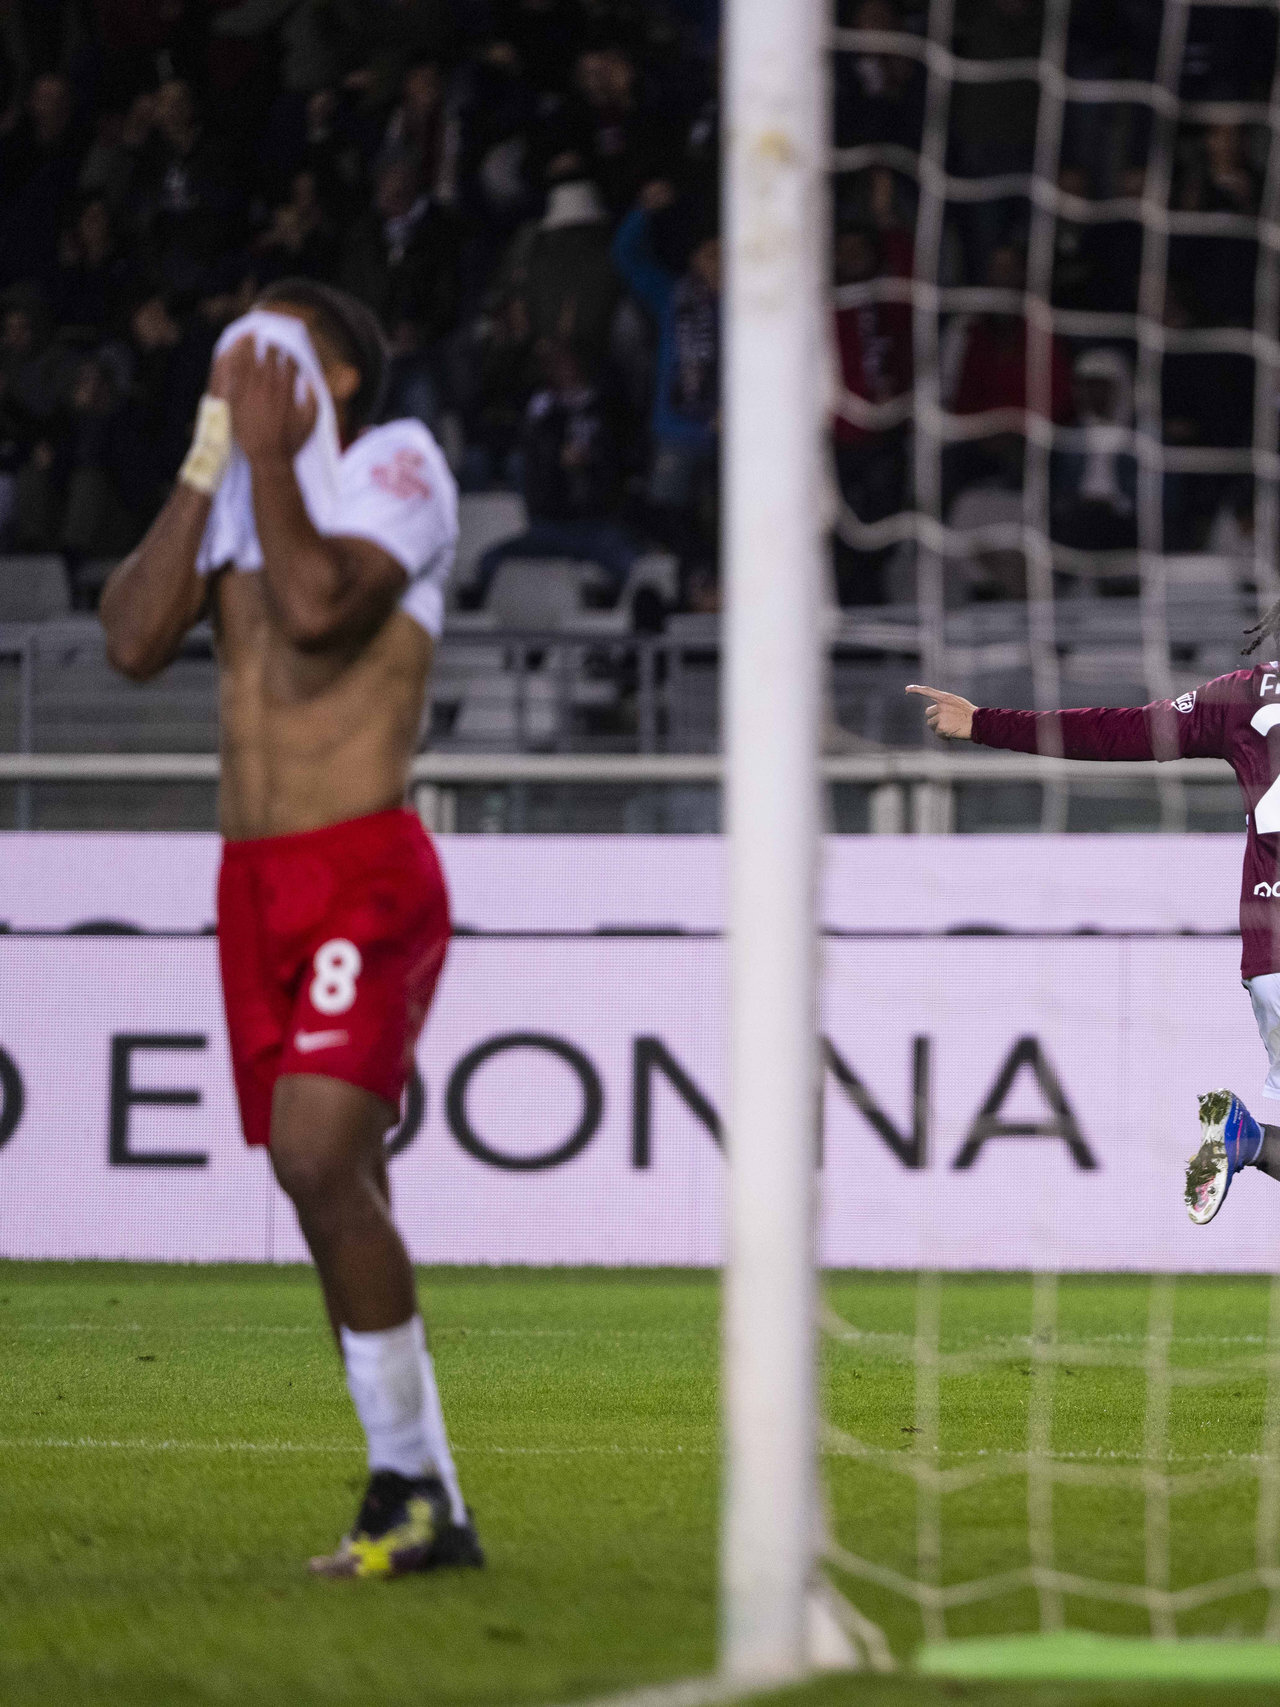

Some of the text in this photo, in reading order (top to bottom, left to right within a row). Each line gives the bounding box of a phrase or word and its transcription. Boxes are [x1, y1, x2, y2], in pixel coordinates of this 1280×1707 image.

[309, 937, 362, 1014] 8
[108, 1032, 209, 1168] E
[388, 1031, 1102, 1173] ONNA
